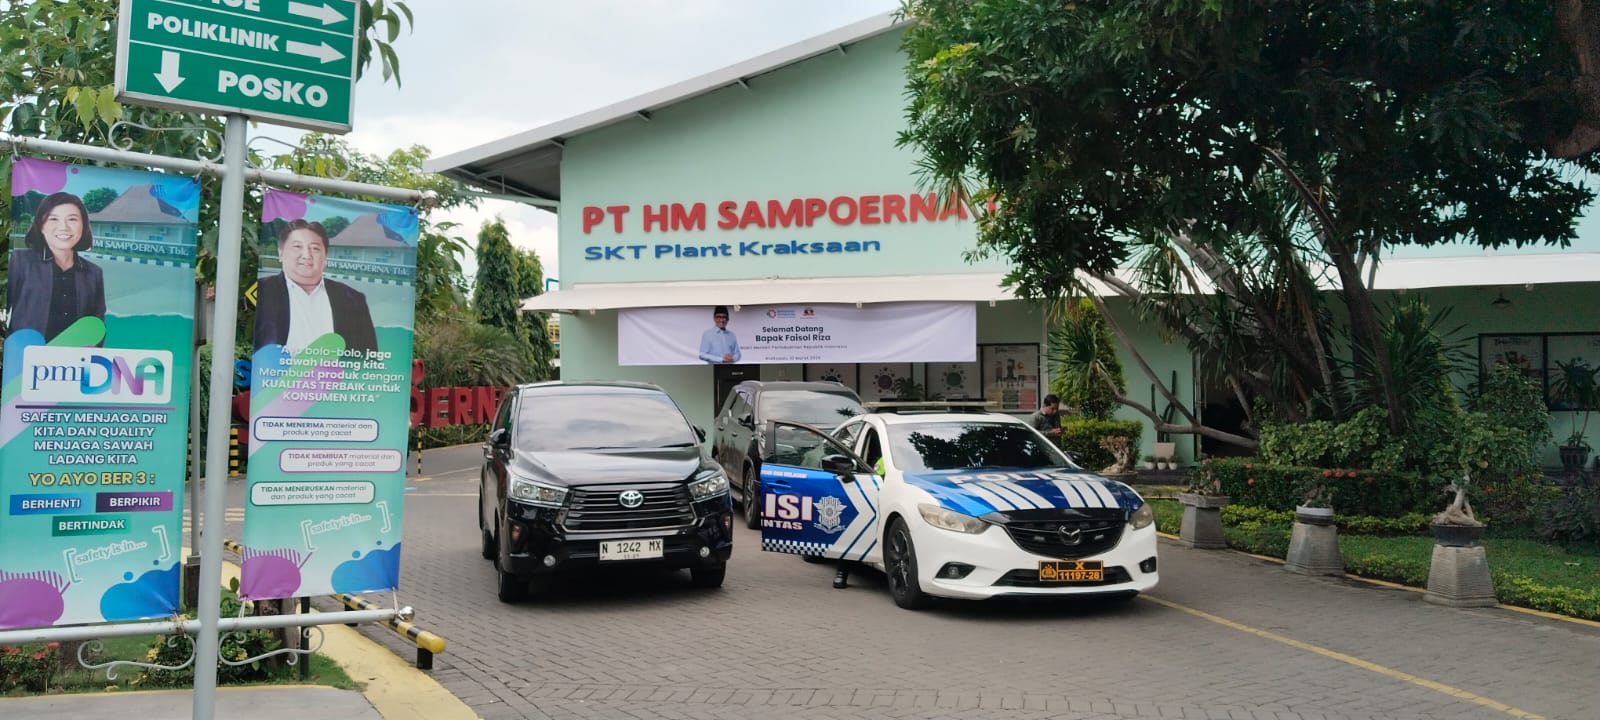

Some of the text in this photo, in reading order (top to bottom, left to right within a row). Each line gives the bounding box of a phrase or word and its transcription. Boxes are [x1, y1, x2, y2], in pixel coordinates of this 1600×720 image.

[147, 12, 279, 51] POLIKLINIK
[218, 70, 328, 108] POSKO
[582, 205, 630, 234] PT
[643, 201, 706, 232] HM
[717, 192, 968, 229] SAMPOERNA
[105, 240, 165, 254] SAMPOERNA
[584, 238, 881, 261] SKT Plant Kraksaan
[339, 261, 389, 273] SAMPOERNA
[795, 326, 824, 334] Datang
[755, 335, 783, 343] Bapak
[785, 333, 811, 342] Faisol
[305, 347, 363, 359] bolo-bolo,
[365, 349, 391, 360] jaga
[279, 357, 387, 370] sawah ladang kita.
[259, 367, 404, 383] Membuat produk dengan
[261, 379, 401, 393] KUALITAS TERBAIK untuk
[283, 391, 347, 402] KONSUMEN
[22, 412, 168, 424] SAFETY MENJAGA DIRI
[33, 426, 155, 438] KITA DAN QUALITY
[282, 429, 309, 437] produk
[310, 430, 329, 438] yang
[34, 440, 154, 451] MENJAGA SAWAH
[49, 454, 138, 465] LADANG KITA
[307, 460, 333, 468] produk
[28, 472, 56, 487] YO
[58, 472, 98, 486] AYO
[100, 471, 134, 486] BER
[135, 471, 147, 485] 3
[22, 496, 161, 509] BERHENTI BERPIKIR
[288, 493, 314, 501] produk
[315, 493, 333, 501] yang
[761, 492, 812, 521] ISI
[58, 519, 125, 531] BERTINDAK
[602, 540, 661, 554] N 1242 MX
[75, 545, 111, 564] safety
[111, 543, 122, 555] is
[1075, 561, 1085, 570] X
[1059, 571, 1100, 579] 11197-28
